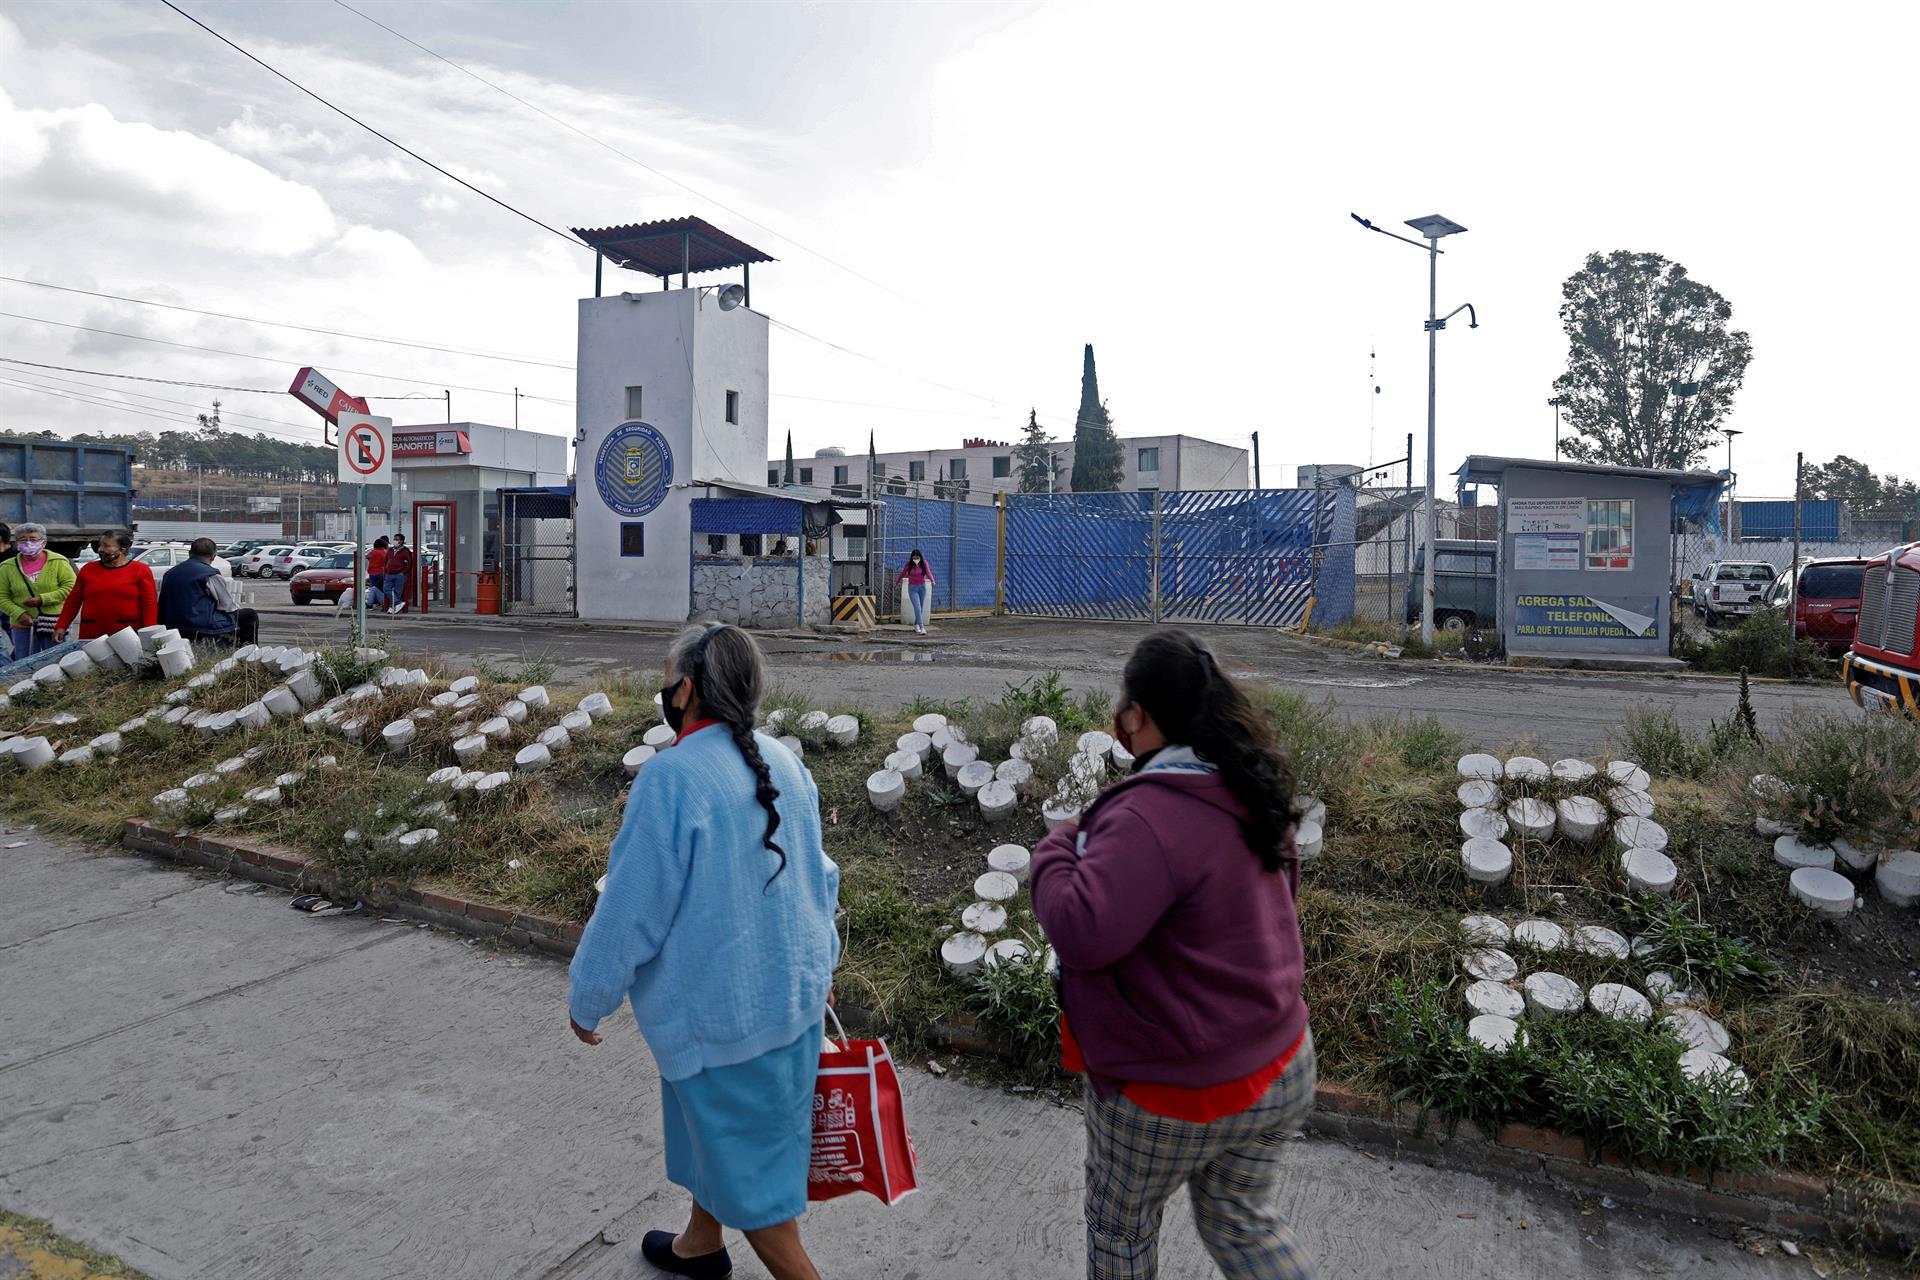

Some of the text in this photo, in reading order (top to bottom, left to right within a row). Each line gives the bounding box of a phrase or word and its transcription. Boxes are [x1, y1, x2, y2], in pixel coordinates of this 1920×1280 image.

[313, 385, 329, 399] RED
[625, 426, 652, 435] SEGURIDAD
[358, 434, 372, 464] E
[392, 441, 435, 451] BANORTE
[633, 503, 651, 513] ESTATAL
[1517, 596, 1565, 606] AGREGA
[1547, 611, 1615, 622] TELEFONIC
[1516, 625, 1535, 634] PARA
[1536, 625, 1552, 634] QUE
[1553, 626, 1563, 634] TU
[1564, 626, 1598, 635] FAMILIAR
[1600, 627, 1624, 636] PUEDA
